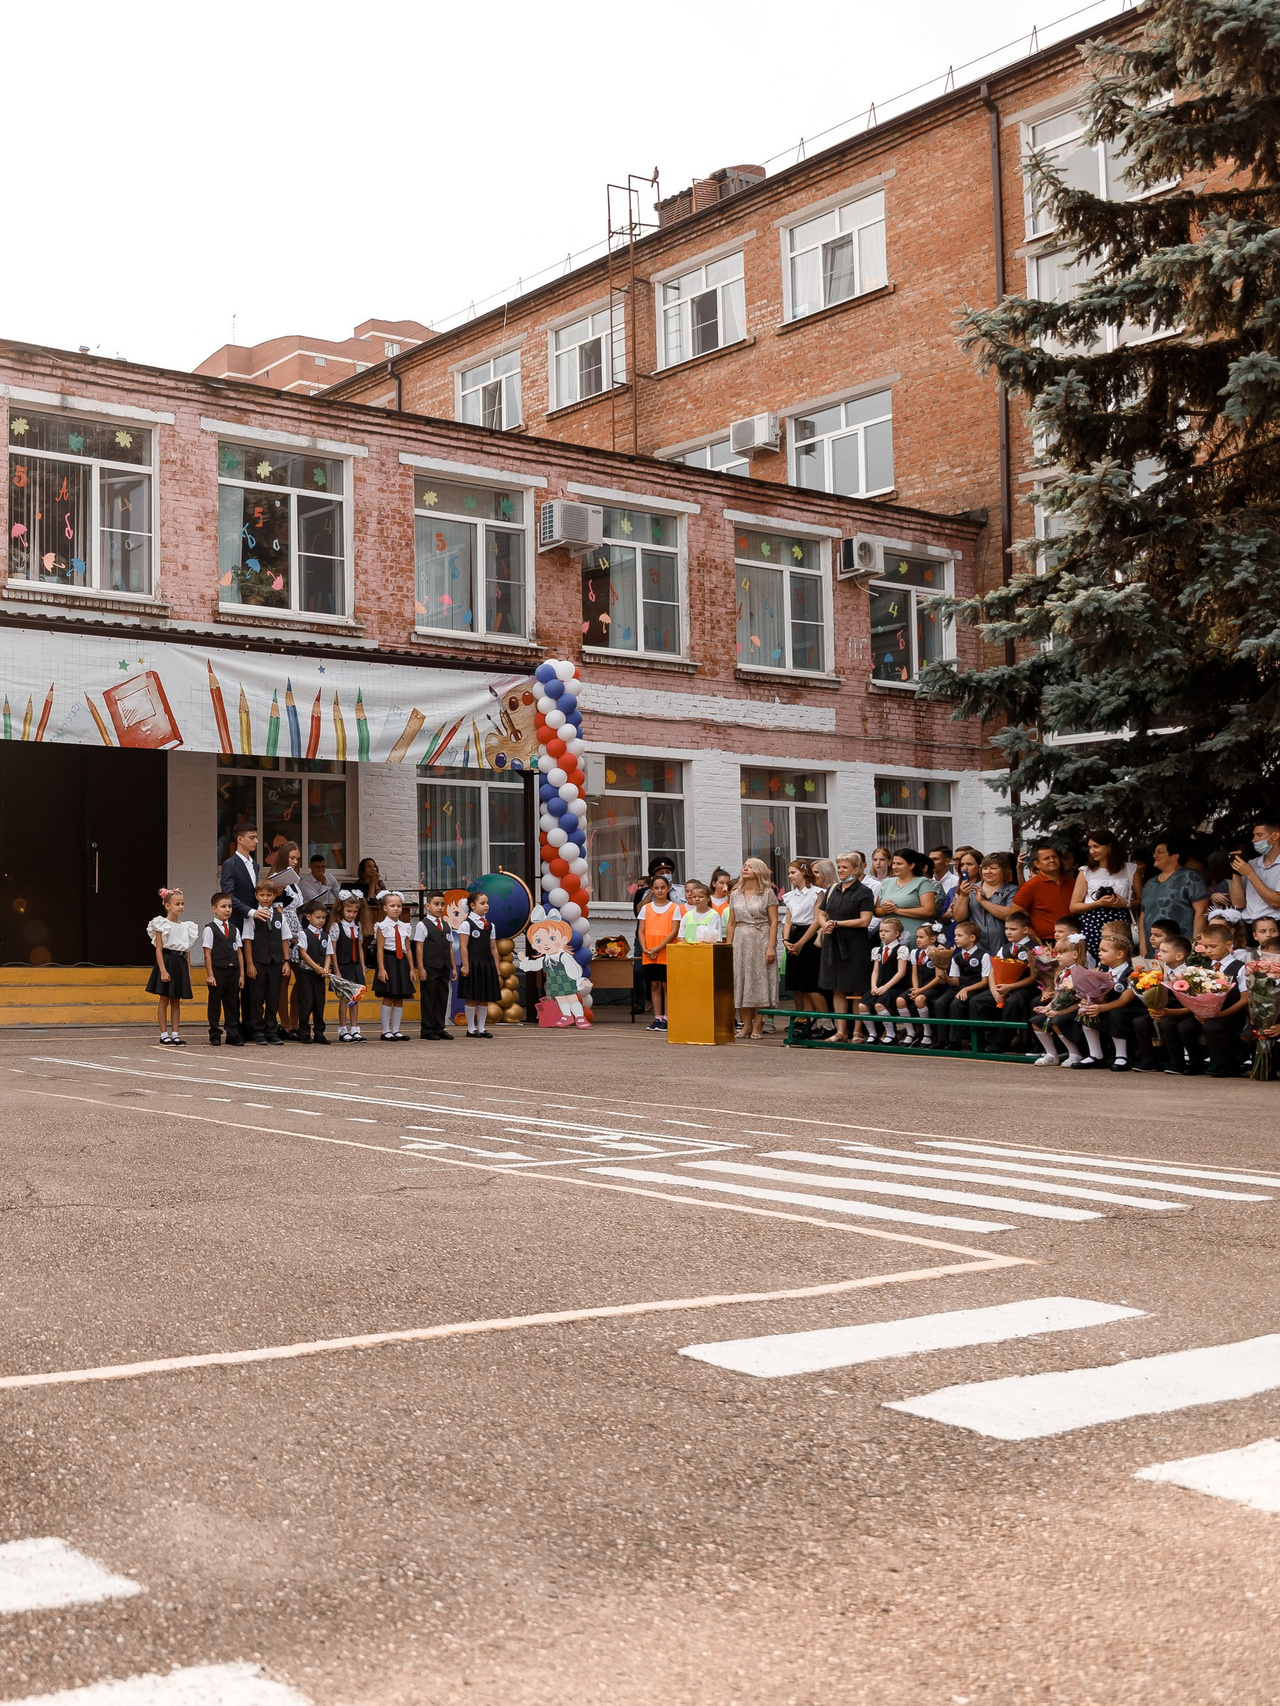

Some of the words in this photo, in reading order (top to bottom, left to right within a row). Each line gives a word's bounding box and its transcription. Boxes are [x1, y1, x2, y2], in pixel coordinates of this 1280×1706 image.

[13, 464, 28, 488] 5
[254, 507, 264, 528] 5
[324, 518, 333, 534] 4
[436, 532, 446, 552] 5
[489, 542, 498, 556] 4
[598, 556, 610, 570] 4
[648, 568, 660, 584] 5
[741, 577, 750, 592] 4
[888, 602, 898, 618] 4
[442, 800, 453, 816] 4
[888, 826, 896, 840] 4
